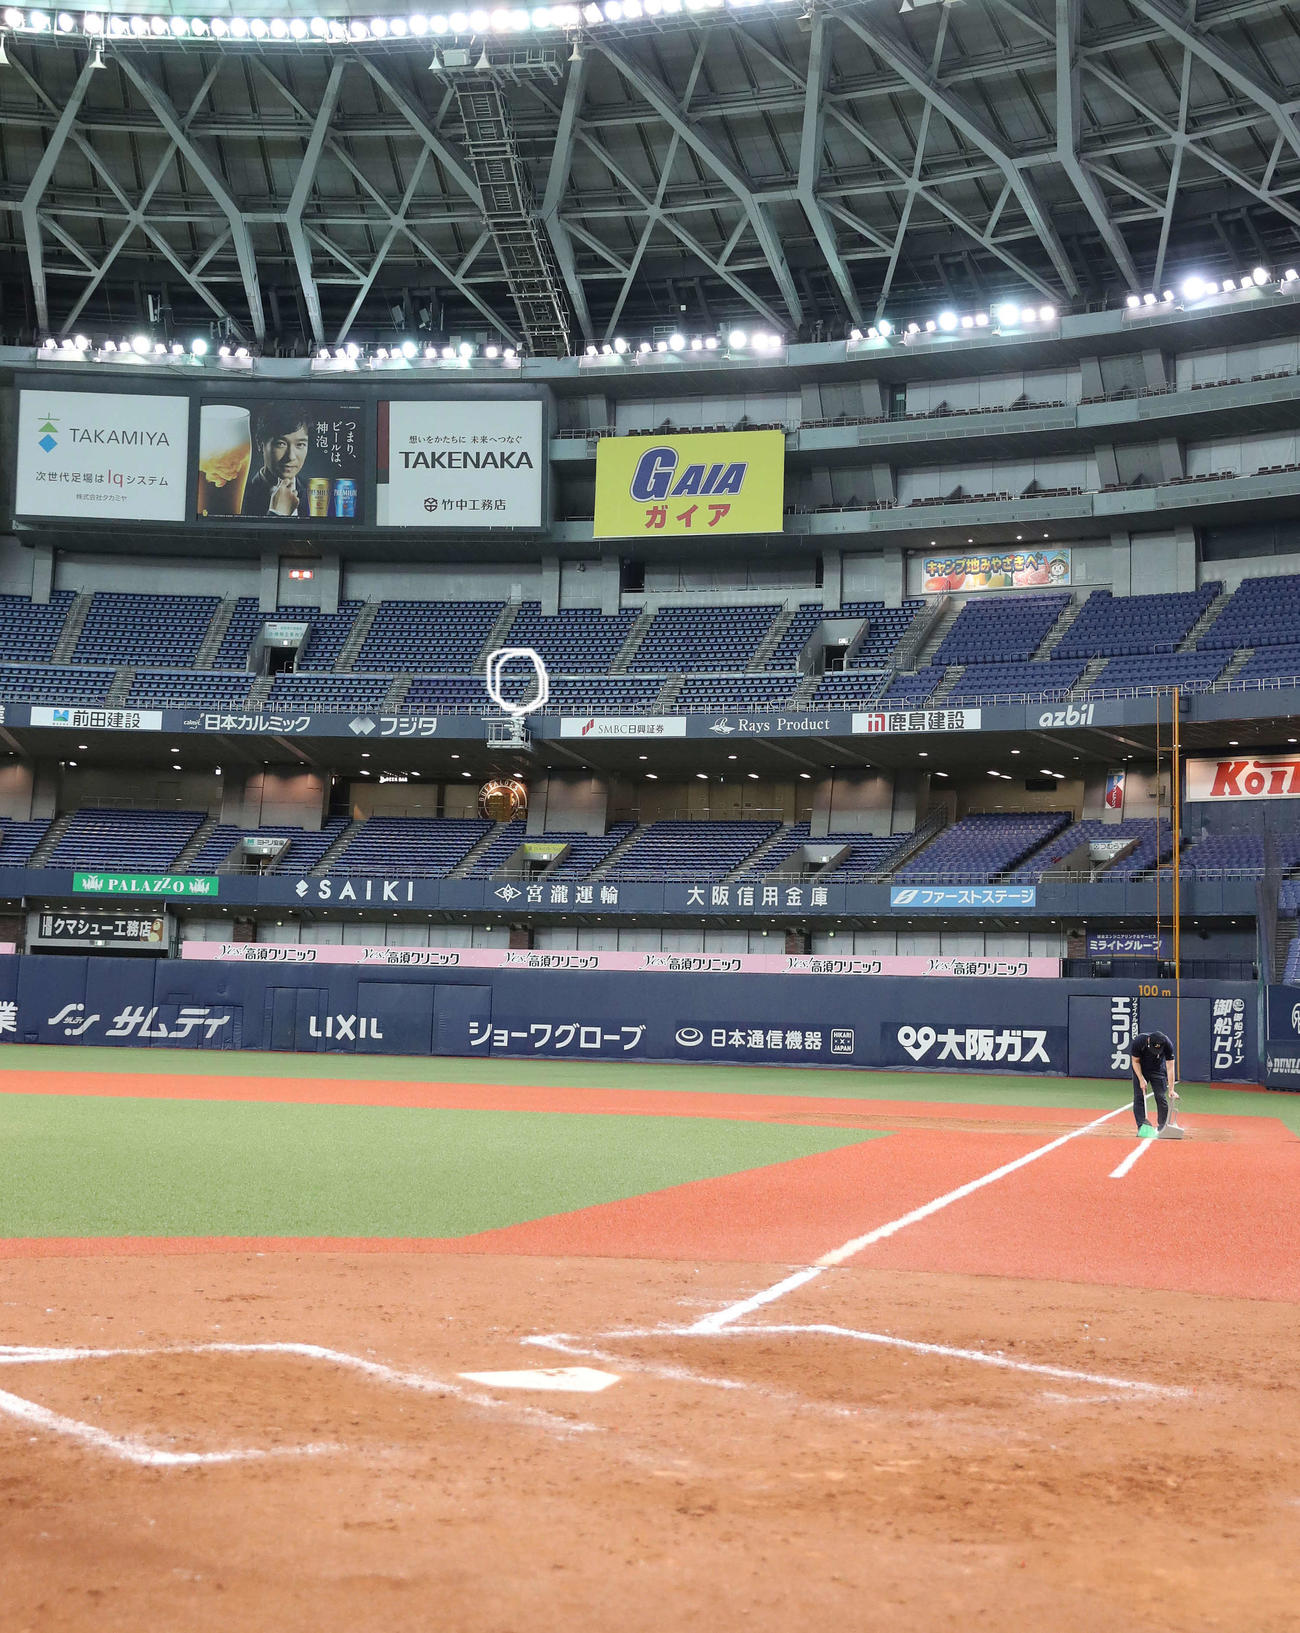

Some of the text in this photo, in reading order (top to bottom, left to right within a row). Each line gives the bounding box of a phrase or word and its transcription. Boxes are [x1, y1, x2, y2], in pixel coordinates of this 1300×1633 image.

[69, 427, 170, 447] TAKAMIYA
[316, 421, 328, 454] 神泡。
[331, 421, 342, 467] ビールは、
[346, 421, 356, 458] つまり、
[409, 435, 523, 444] 想いをかたちに 未来へつなぐ
[398, 451, 533, 469] TAKENAKA
[629, 445, 749, 503] GAIA
[76, 493, 128, 502] 株式会社タカミヤ
[441, 498, 506, 511] 竹中工務店
[645, 503, 731, 529] ガイア
[926, 552, 1038, 577] キャンプ地みやざきへ
[73, 710, 141, 729] 前田建設
[205, 714, 311, 732] 日本カルミック
[888, 711, 965, 732] 鹿島建設
[1038, 703, 1095, 727] azbil
[380, 717, 437, 736] フジタ
[598, 724, 664, 734] SMBC日興証券
[738, 717, 830, 734] Rays Product
[108, 877, 185, 893] PALAZZO
[318, 879, 413, 902] SAIKI
[526, 884, 619, 904] 宮瀧運輸
[686, 885, 829, 907] 大阪信用金庫
[921, 888, 1035, 905] ファーストステージ
[54, 917, 152, 938] クマシュー工務店
[244, 947, 317, 962] 高須クリニック
[1090, 940, 1163, 951] ミライトグループ
[386, 951, 460, 966] 高須クリニック
[528, 954, 599, 969] 高須クリニック
[668, 957, 742, 972] 高須クリニック
[810, 960, 882, 974] 高須クリニック
[952, 961, 1028, 976] 高須クリニック
[1138, 985, 1171, 997] 100 m
[105, 1006, 231, 1039] サムティ
[309, 1014, 383, 1041] LIXIL
[469, 1022, 646, 1050] ショーワグローブ
[711, 1029, 823, 1050] 日本通信機器
[1111, 997, 1131, 1070] エコリカ
[1213, 999, 1233, 1069] 御船HD
[936, 1028, 1050, 1063] 大阪ガス
